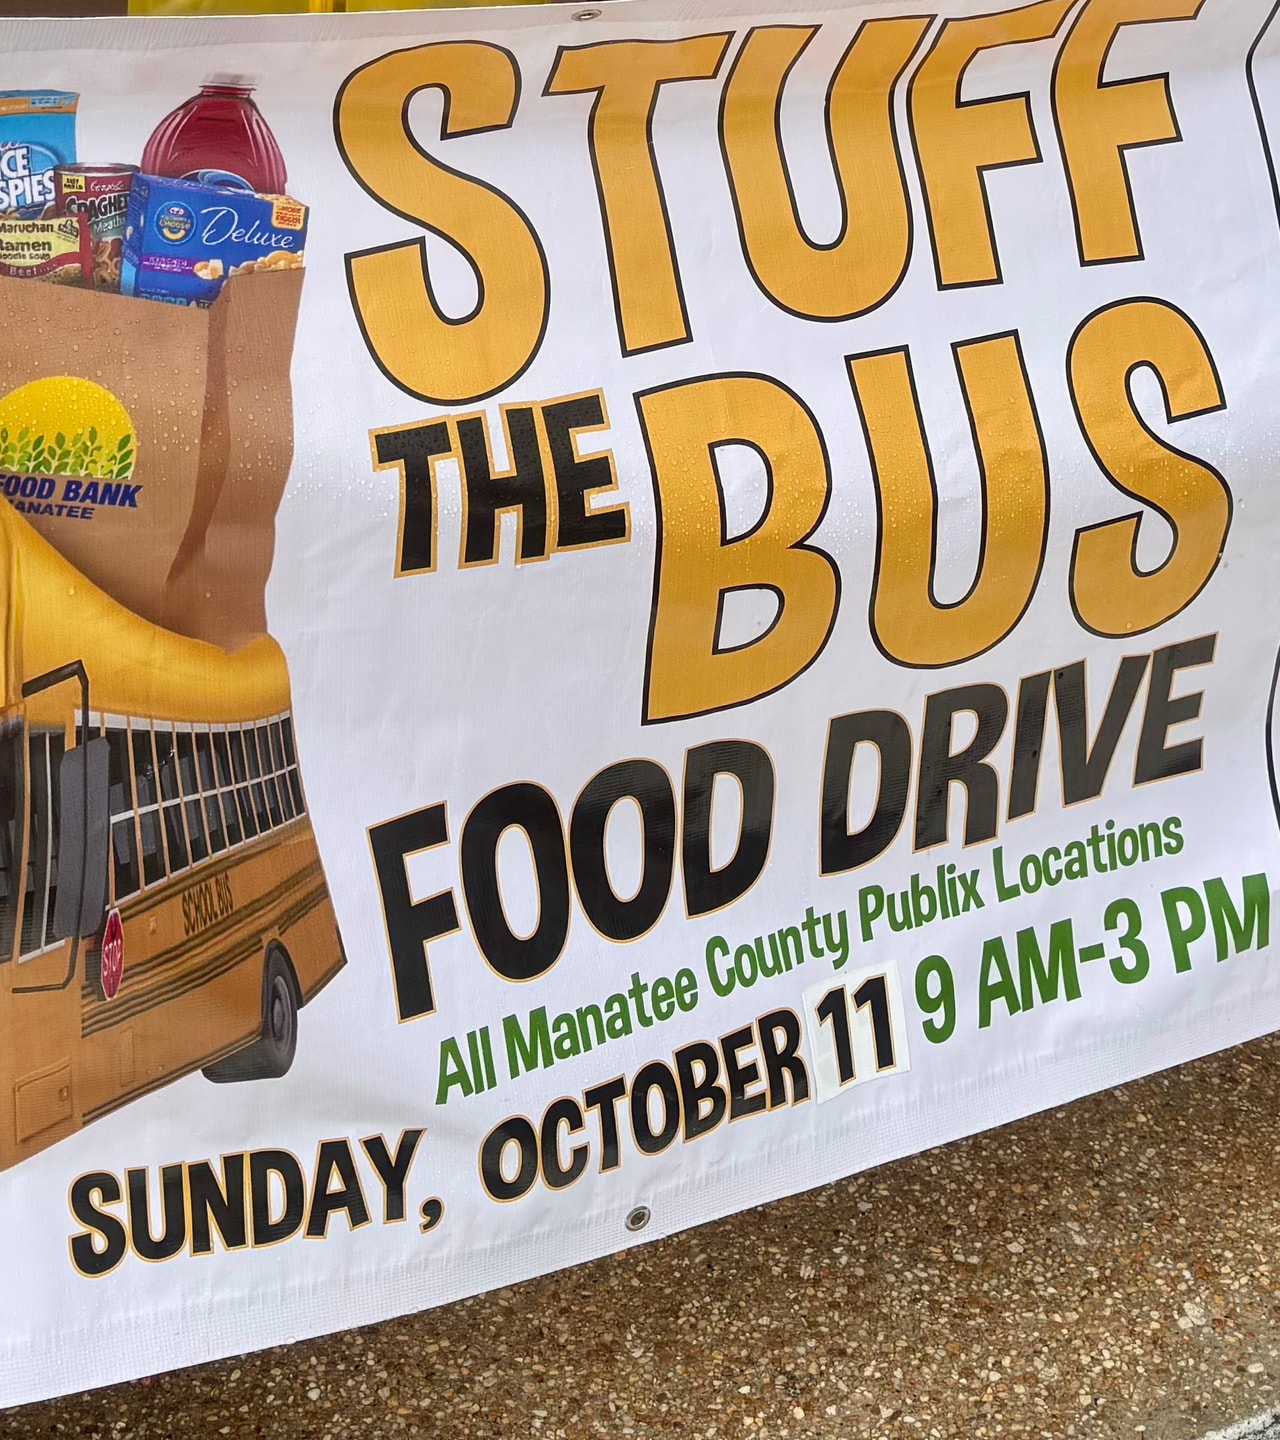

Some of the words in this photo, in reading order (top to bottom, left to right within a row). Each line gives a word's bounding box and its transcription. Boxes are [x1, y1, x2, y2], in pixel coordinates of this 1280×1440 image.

[200, 206, 294, 248] Deluxe
[62, 480, 143, 508] BANK
[369, 388, 631, 579] THE
[633, 296, 1232, 726] BUS
[182, 880, 219, 937] SCHOOL
[215, 871, 234, 916] BUS
[367, 738, 776, 1025] FOOD
[819, 633, 1218, 878] DRIVE
[434, 1031, 495, 1105] All
[505, 967, 699, 1083] Manatee
[706, 909, 848, 971] County
[859, 868, 982, 943] Publix
[995, 815, 1185, 903] Locations
[66, 1127, 446, 1276] SUNDAY,
[480, 1007, 810, 1204] OCTOBER
[817, 973, 899, 1088] 11
[914, 970, 958, 1045] 9
[1167, 872, 1272, 977] PM
